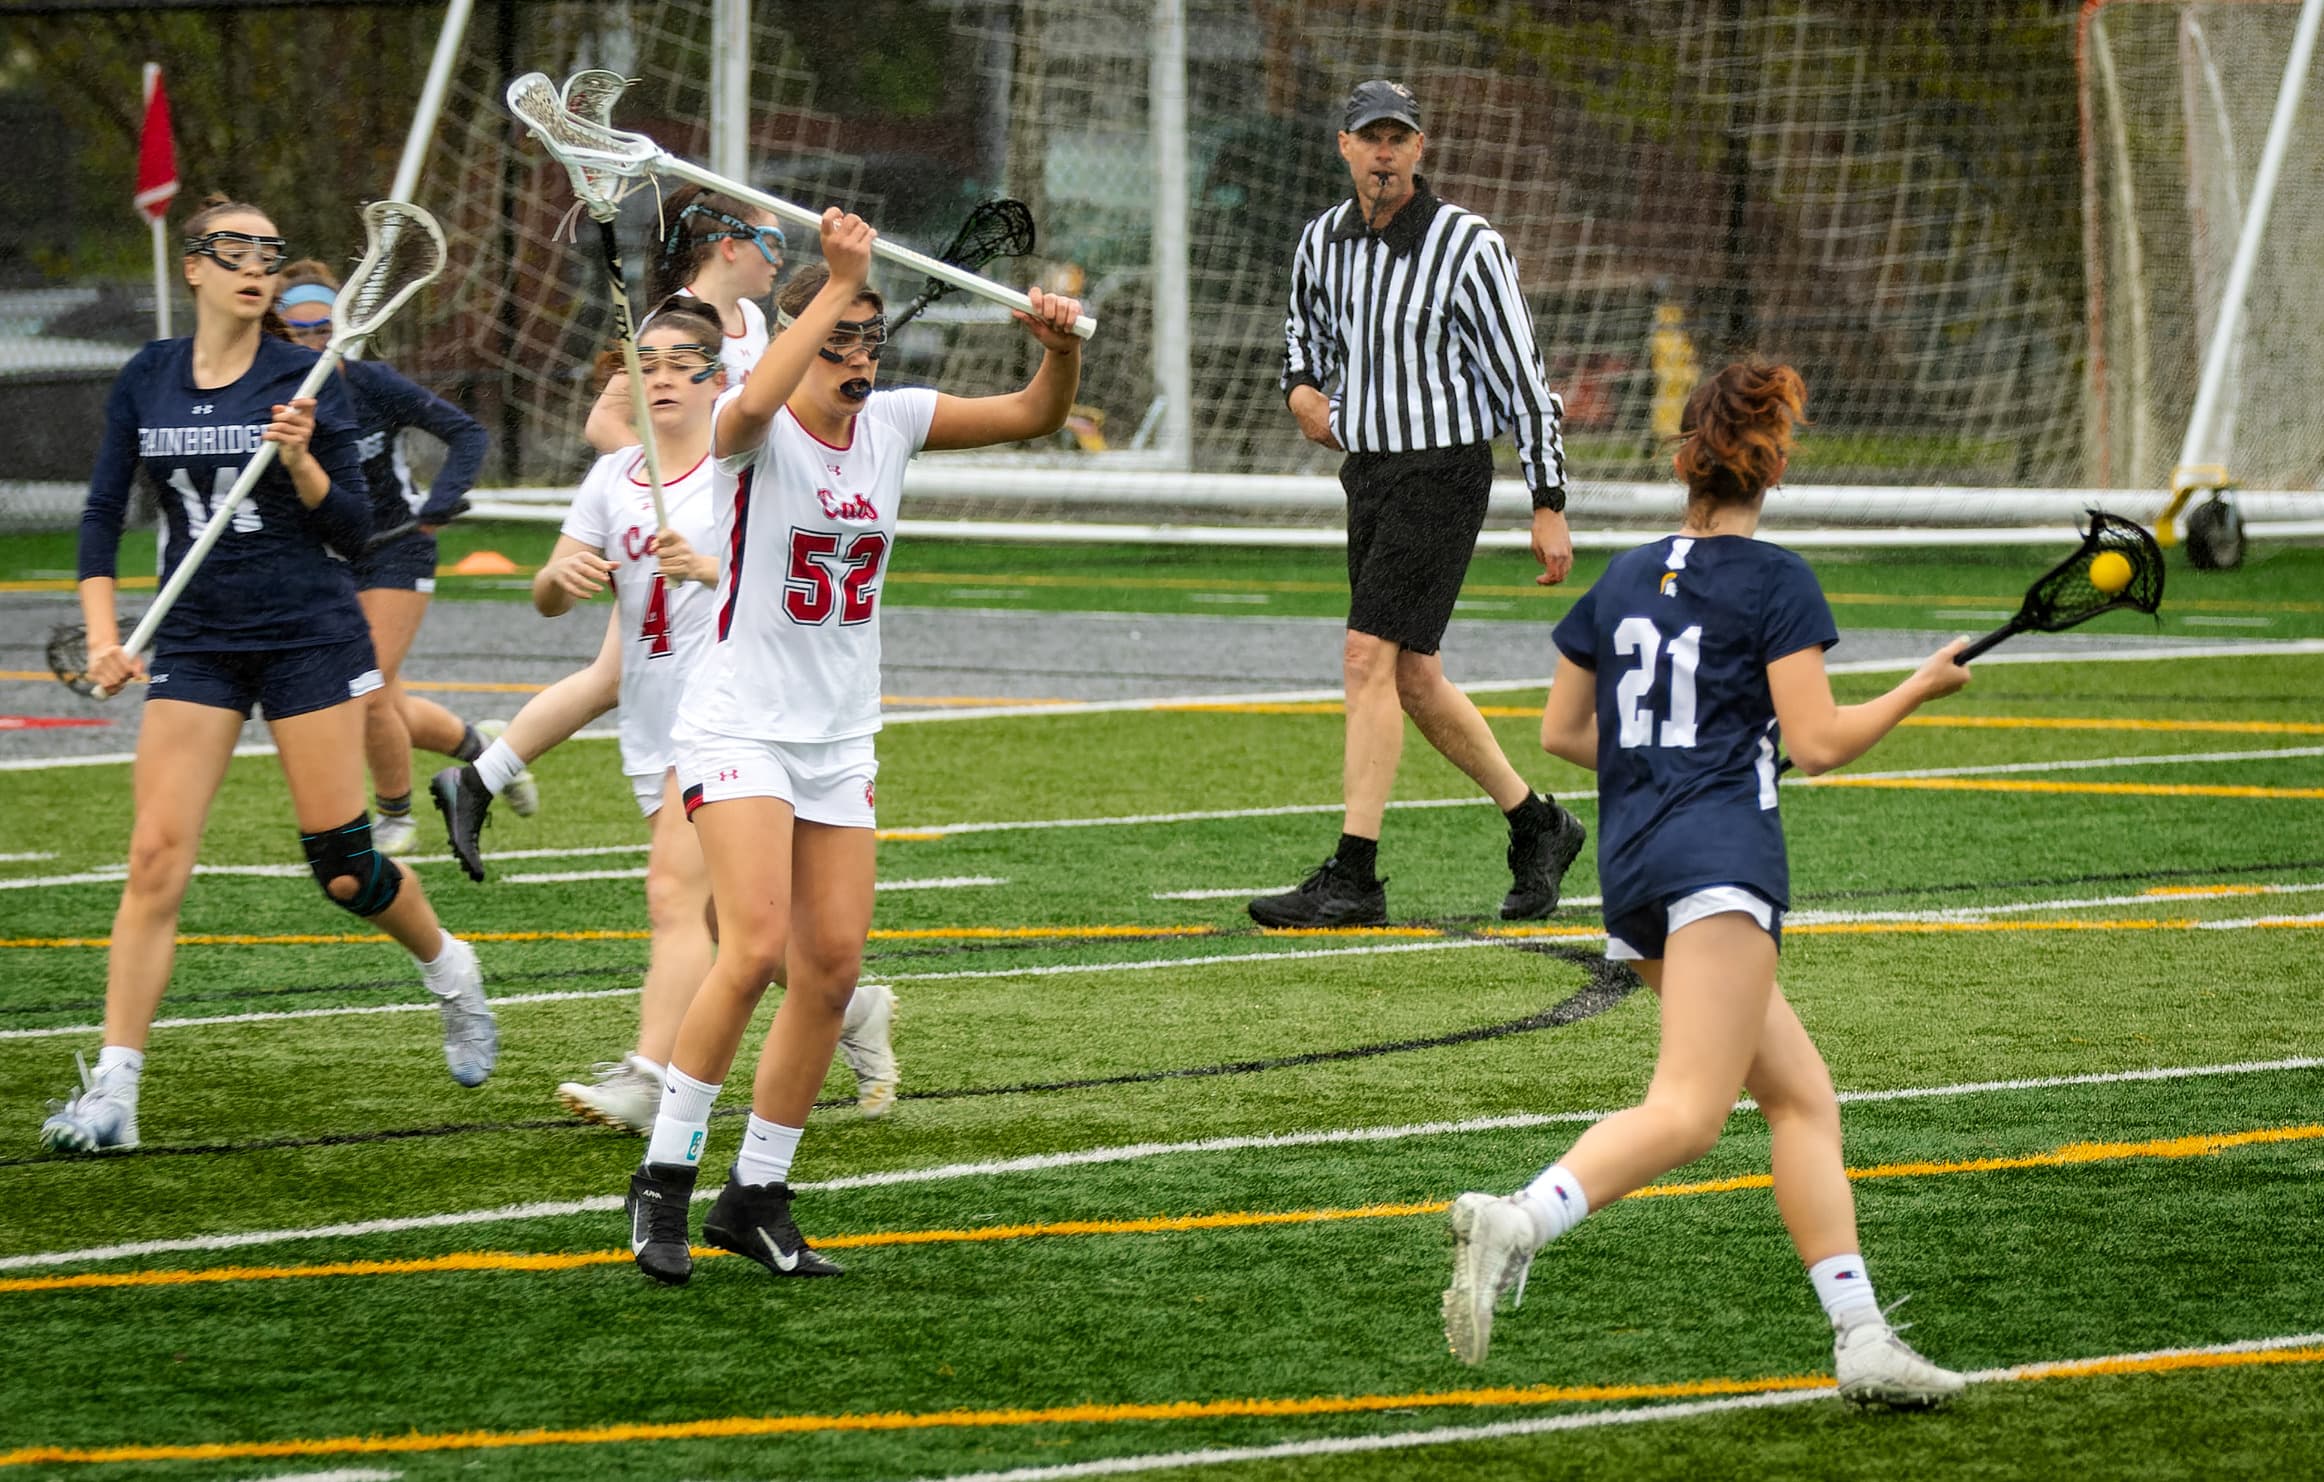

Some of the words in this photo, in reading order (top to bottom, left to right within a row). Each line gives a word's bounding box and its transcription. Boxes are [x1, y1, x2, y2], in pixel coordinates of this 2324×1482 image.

[138, 424, 270, 457] BAINBRIDG
[167, 467, 264, 540] 14
[816, 487, 879, 522] Cats
[637, 571, 674, 660] 4
[782, 525, 889, 627] 52
[1613, 617, 1703, 749] 21
